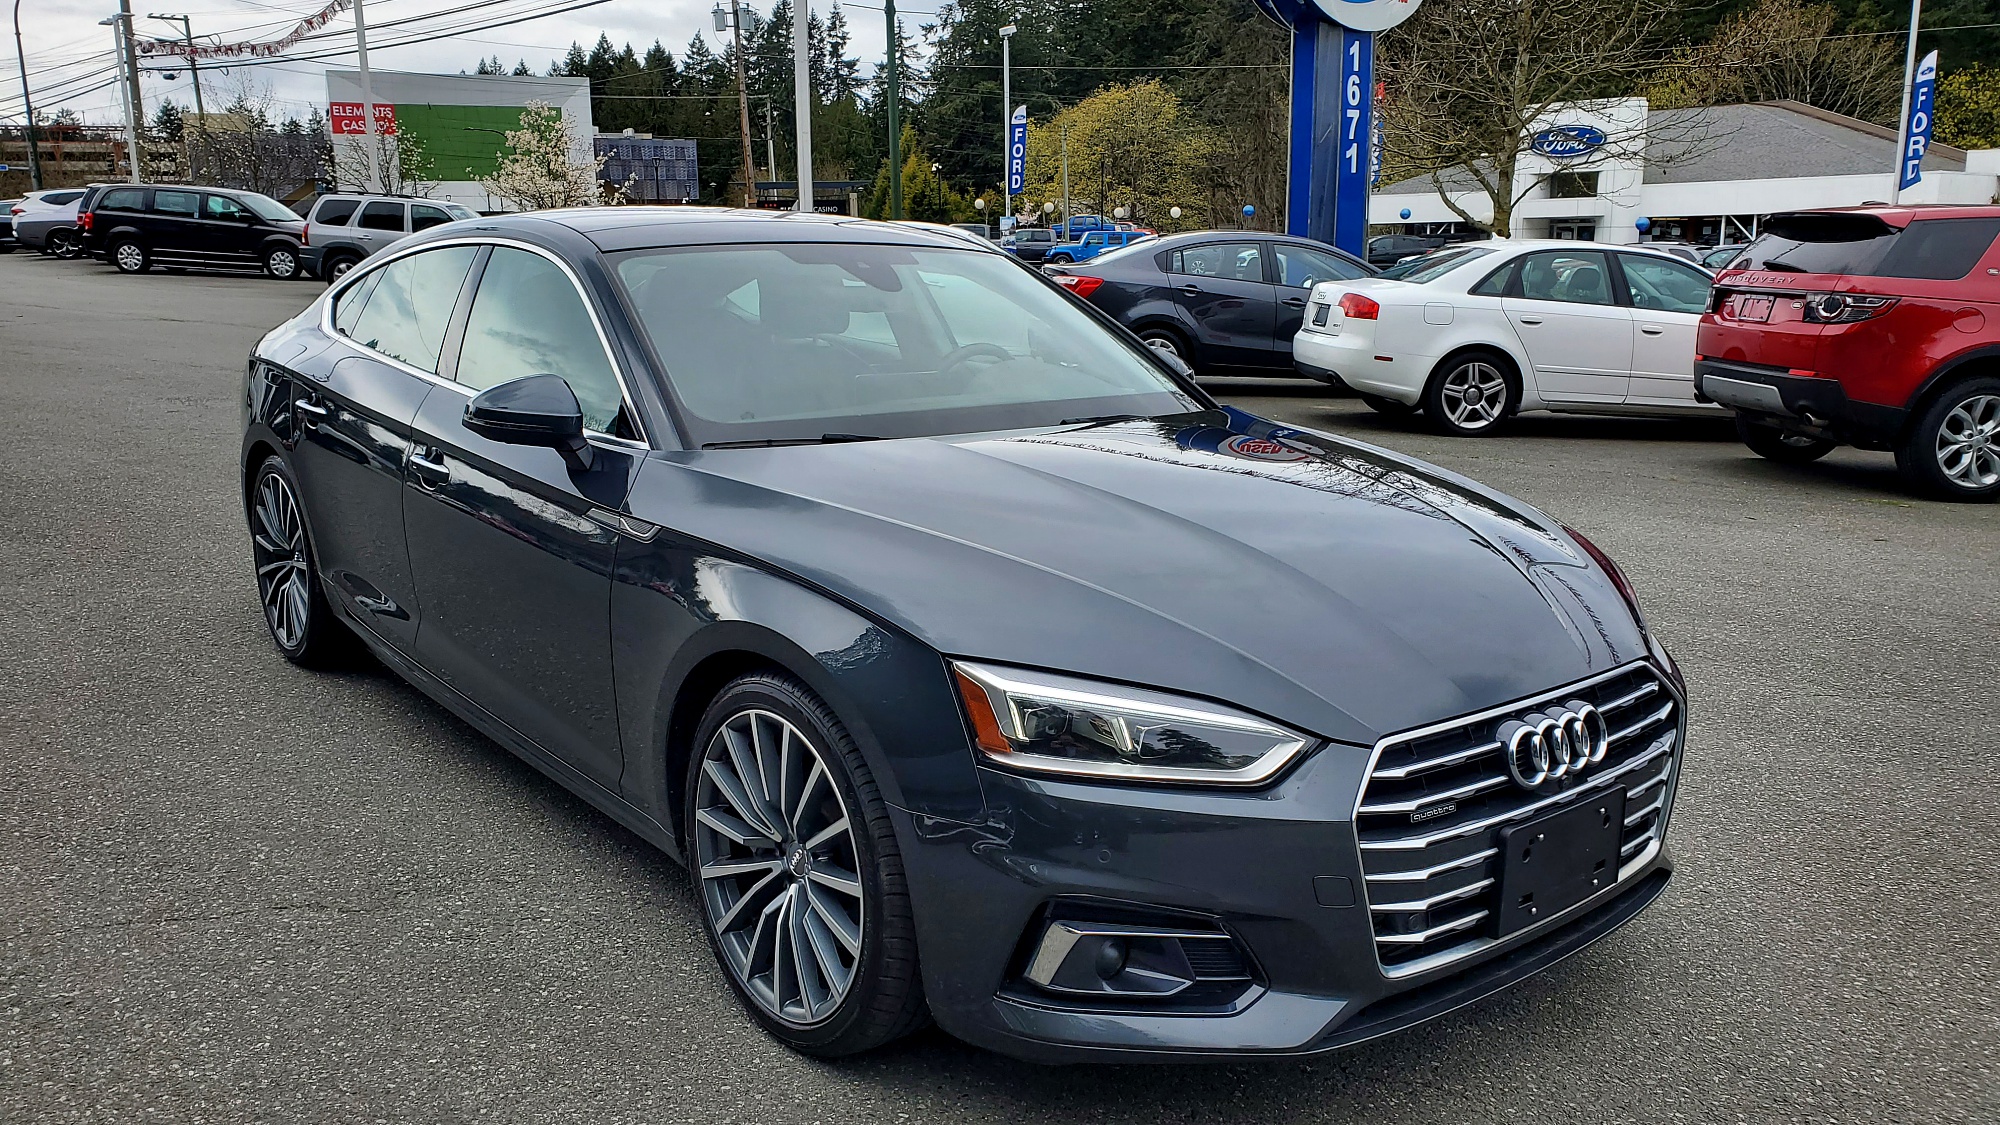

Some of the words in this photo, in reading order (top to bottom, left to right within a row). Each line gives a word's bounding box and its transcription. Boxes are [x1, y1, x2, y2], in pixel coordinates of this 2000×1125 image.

[332, 105, 393, 119] ELEMNTS
[1345, 40, 1361, 174] 1671
[341, 119, 387, 132] CASO
[1011, 127, 1024, 189] FORD
[1727, 275, 1797, 285] DISCOVERY
[1413, 804, 1455, 821] quattro
